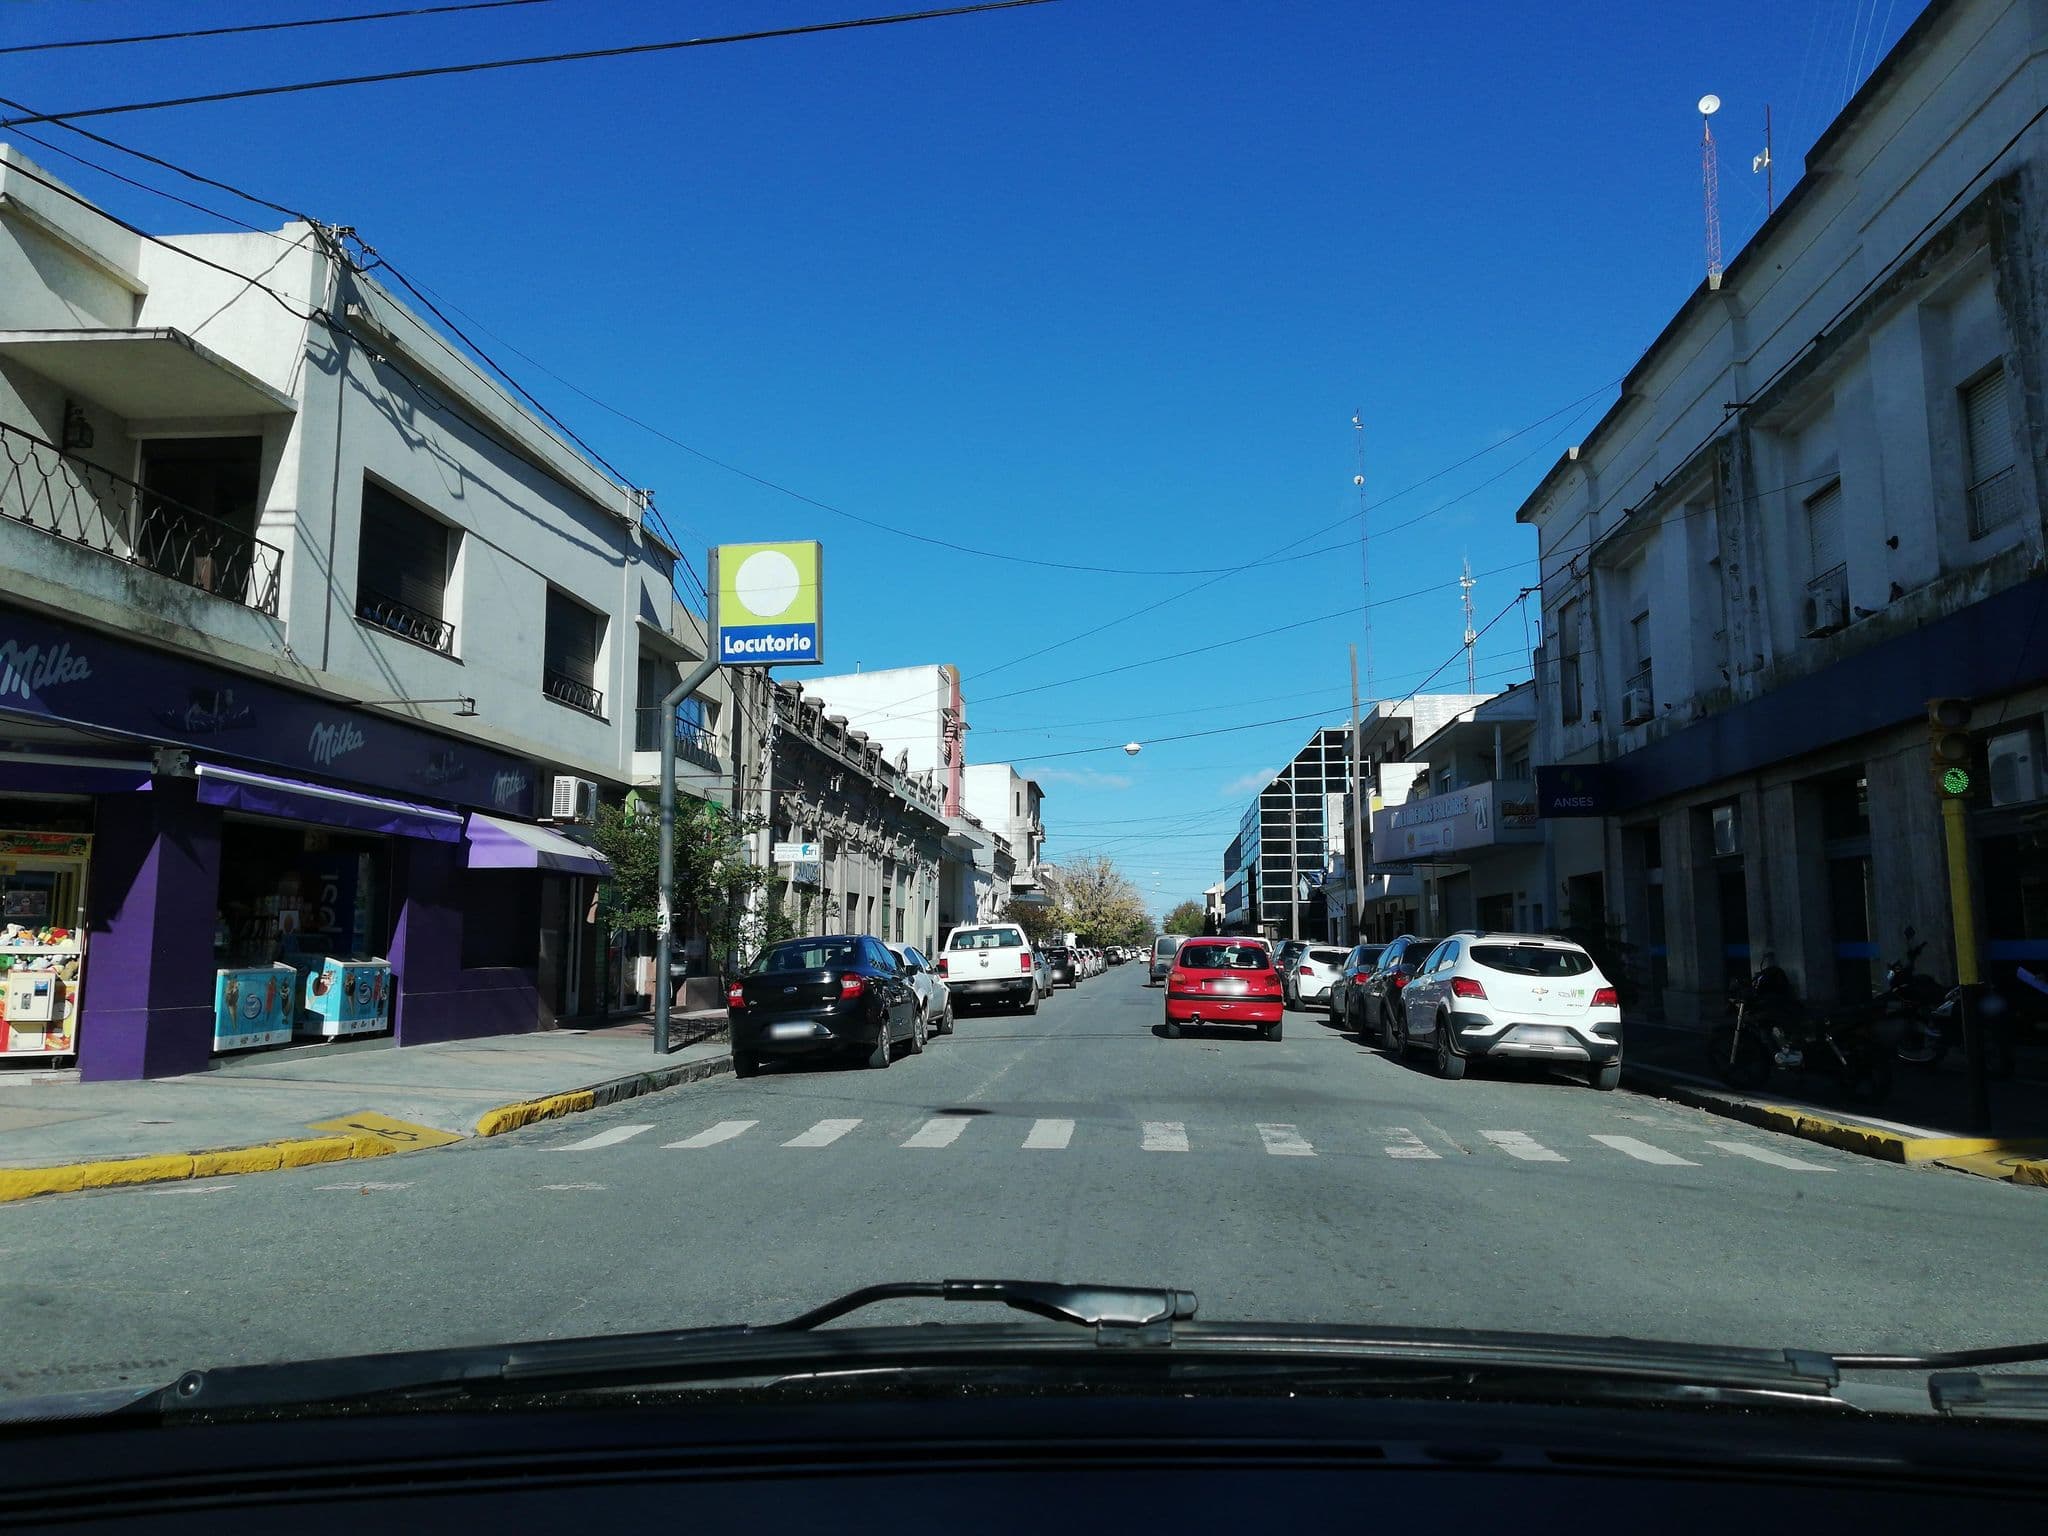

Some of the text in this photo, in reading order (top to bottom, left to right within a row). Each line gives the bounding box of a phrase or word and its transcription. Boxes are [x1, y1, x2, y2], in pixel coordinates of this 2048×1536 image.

[724, 633, 811, 654] Locutorio
[0, 639, 93, 700] Milka
[308, 721, 366, 766] Milka
[491, 769, 528, 805] Milka
[1553, 796, 1595, 808] ANSES
